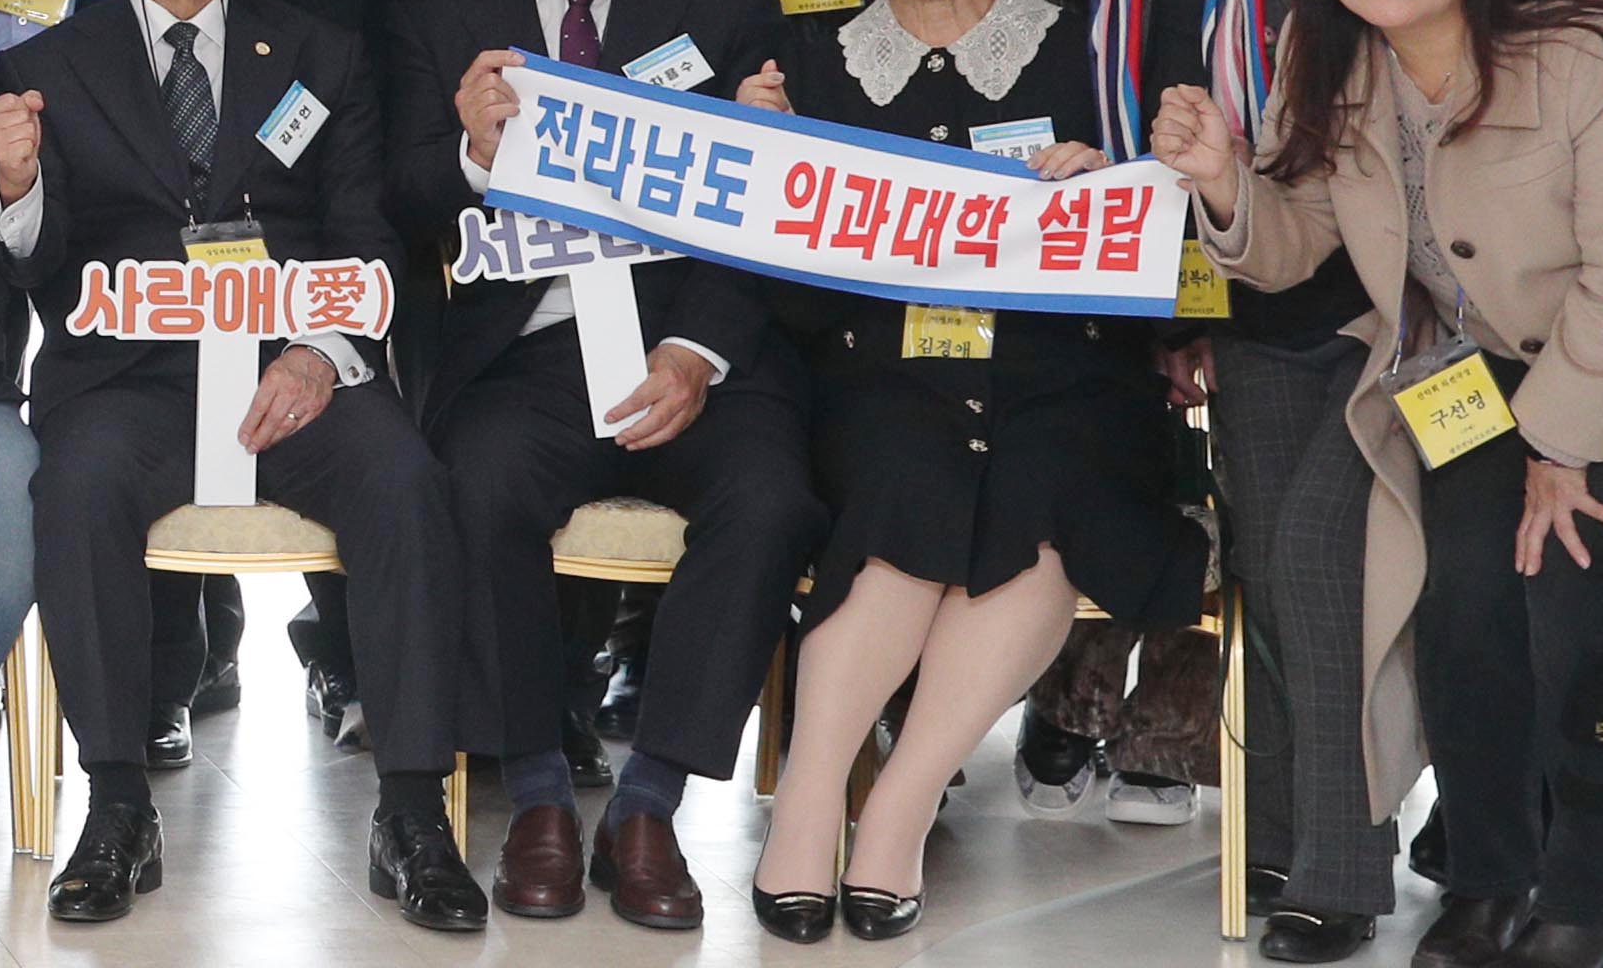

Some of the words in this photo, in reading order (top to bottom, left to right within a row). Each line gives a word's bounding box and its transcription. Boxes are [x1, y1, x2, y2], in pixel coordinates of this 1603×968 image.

[535, 94, 754, 227] 전라남도
[775, 160, 1009, 268] 의과대학
[1037, 184, 1155, 272] 설립
[72, 263, 389, 335] 사랑애(愛)
[918, 336, 971, 359] 김경애
[1430, 389, 1486, 429] 구선영
